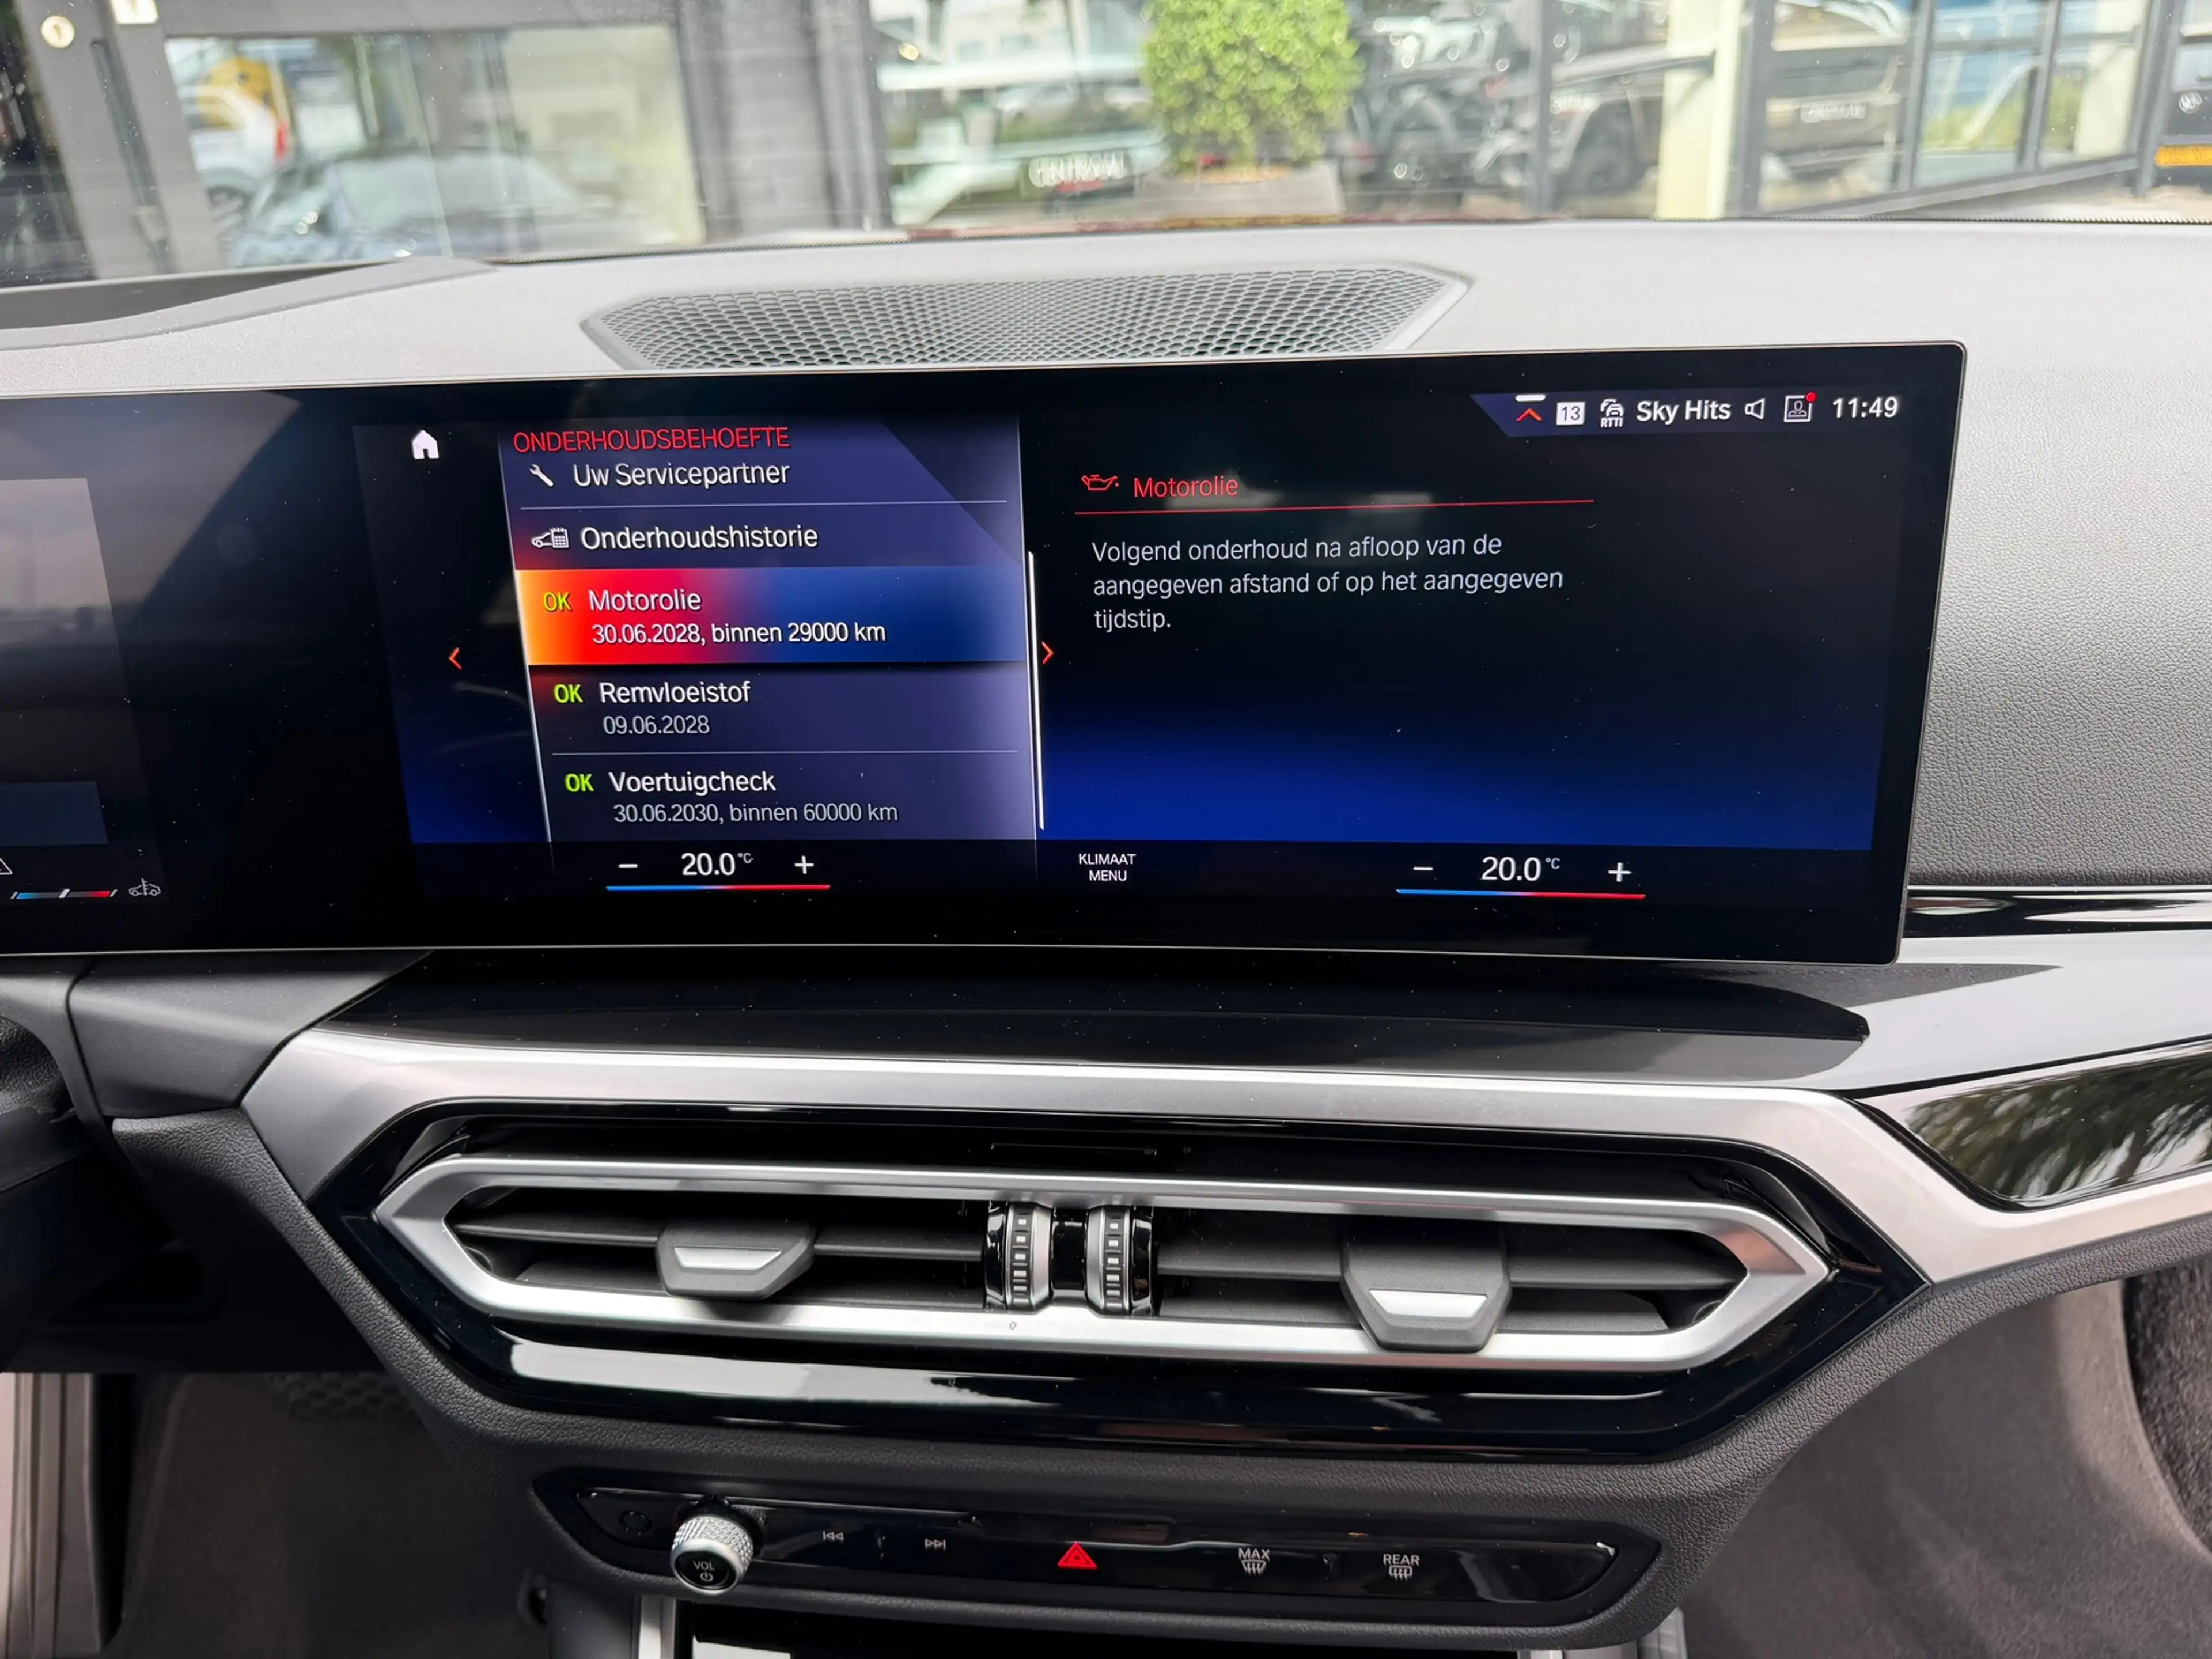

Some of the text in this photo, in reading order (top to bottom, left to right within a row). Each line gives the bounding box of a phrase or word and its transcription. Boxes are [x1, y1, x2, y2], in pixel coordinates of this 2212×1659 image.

[1562, 407, 1580, 420] 13
[1637, 400, 1731, 425] Sky Hits
[1833, 396, 1898, 418] 11:49
[514, 426, 789, 452] ONDERHOUDSBEHOEFTE
[574, 462, 790, 489] Uw Servicepartner
[1134, 476, 1238, 498] Motorolie
[581, 524, 817, 549] Onderhoudshistorie
[1092, 534, 1502, 565] Volgend onderhoud na afloop van de
[1094, 571, 1563, 599] aangegeven afstand of op het aangegeven
[543, 593, 571, 611] OK
[589, 590, 701, 611] Motorolie
[1094, 609, 1171, 632] tijdstip.
[593, 622, 885, 645] 30.06.2028, binnen 29000 km
[554, 684, 583, 703] OK
[599, 681, 751, 703] Remvloeistof
[603, 715, 710, 734] 09.06.2028
[565, 774, 594, 792] OK
[608, 771, 776, 796] Voertuigcheck
[613, 803, 897, 824] 30.06.2030, binnen 60000 km
[1079, 854, 1136, 865] KLIMAAT
[1089, 870, 1127, 881] MENU
[1238, 1548, 1270, 1560] MAX
[1384, 1554, 1419, 1566] REAR
[693, 1560, 715, 1570] VOL
